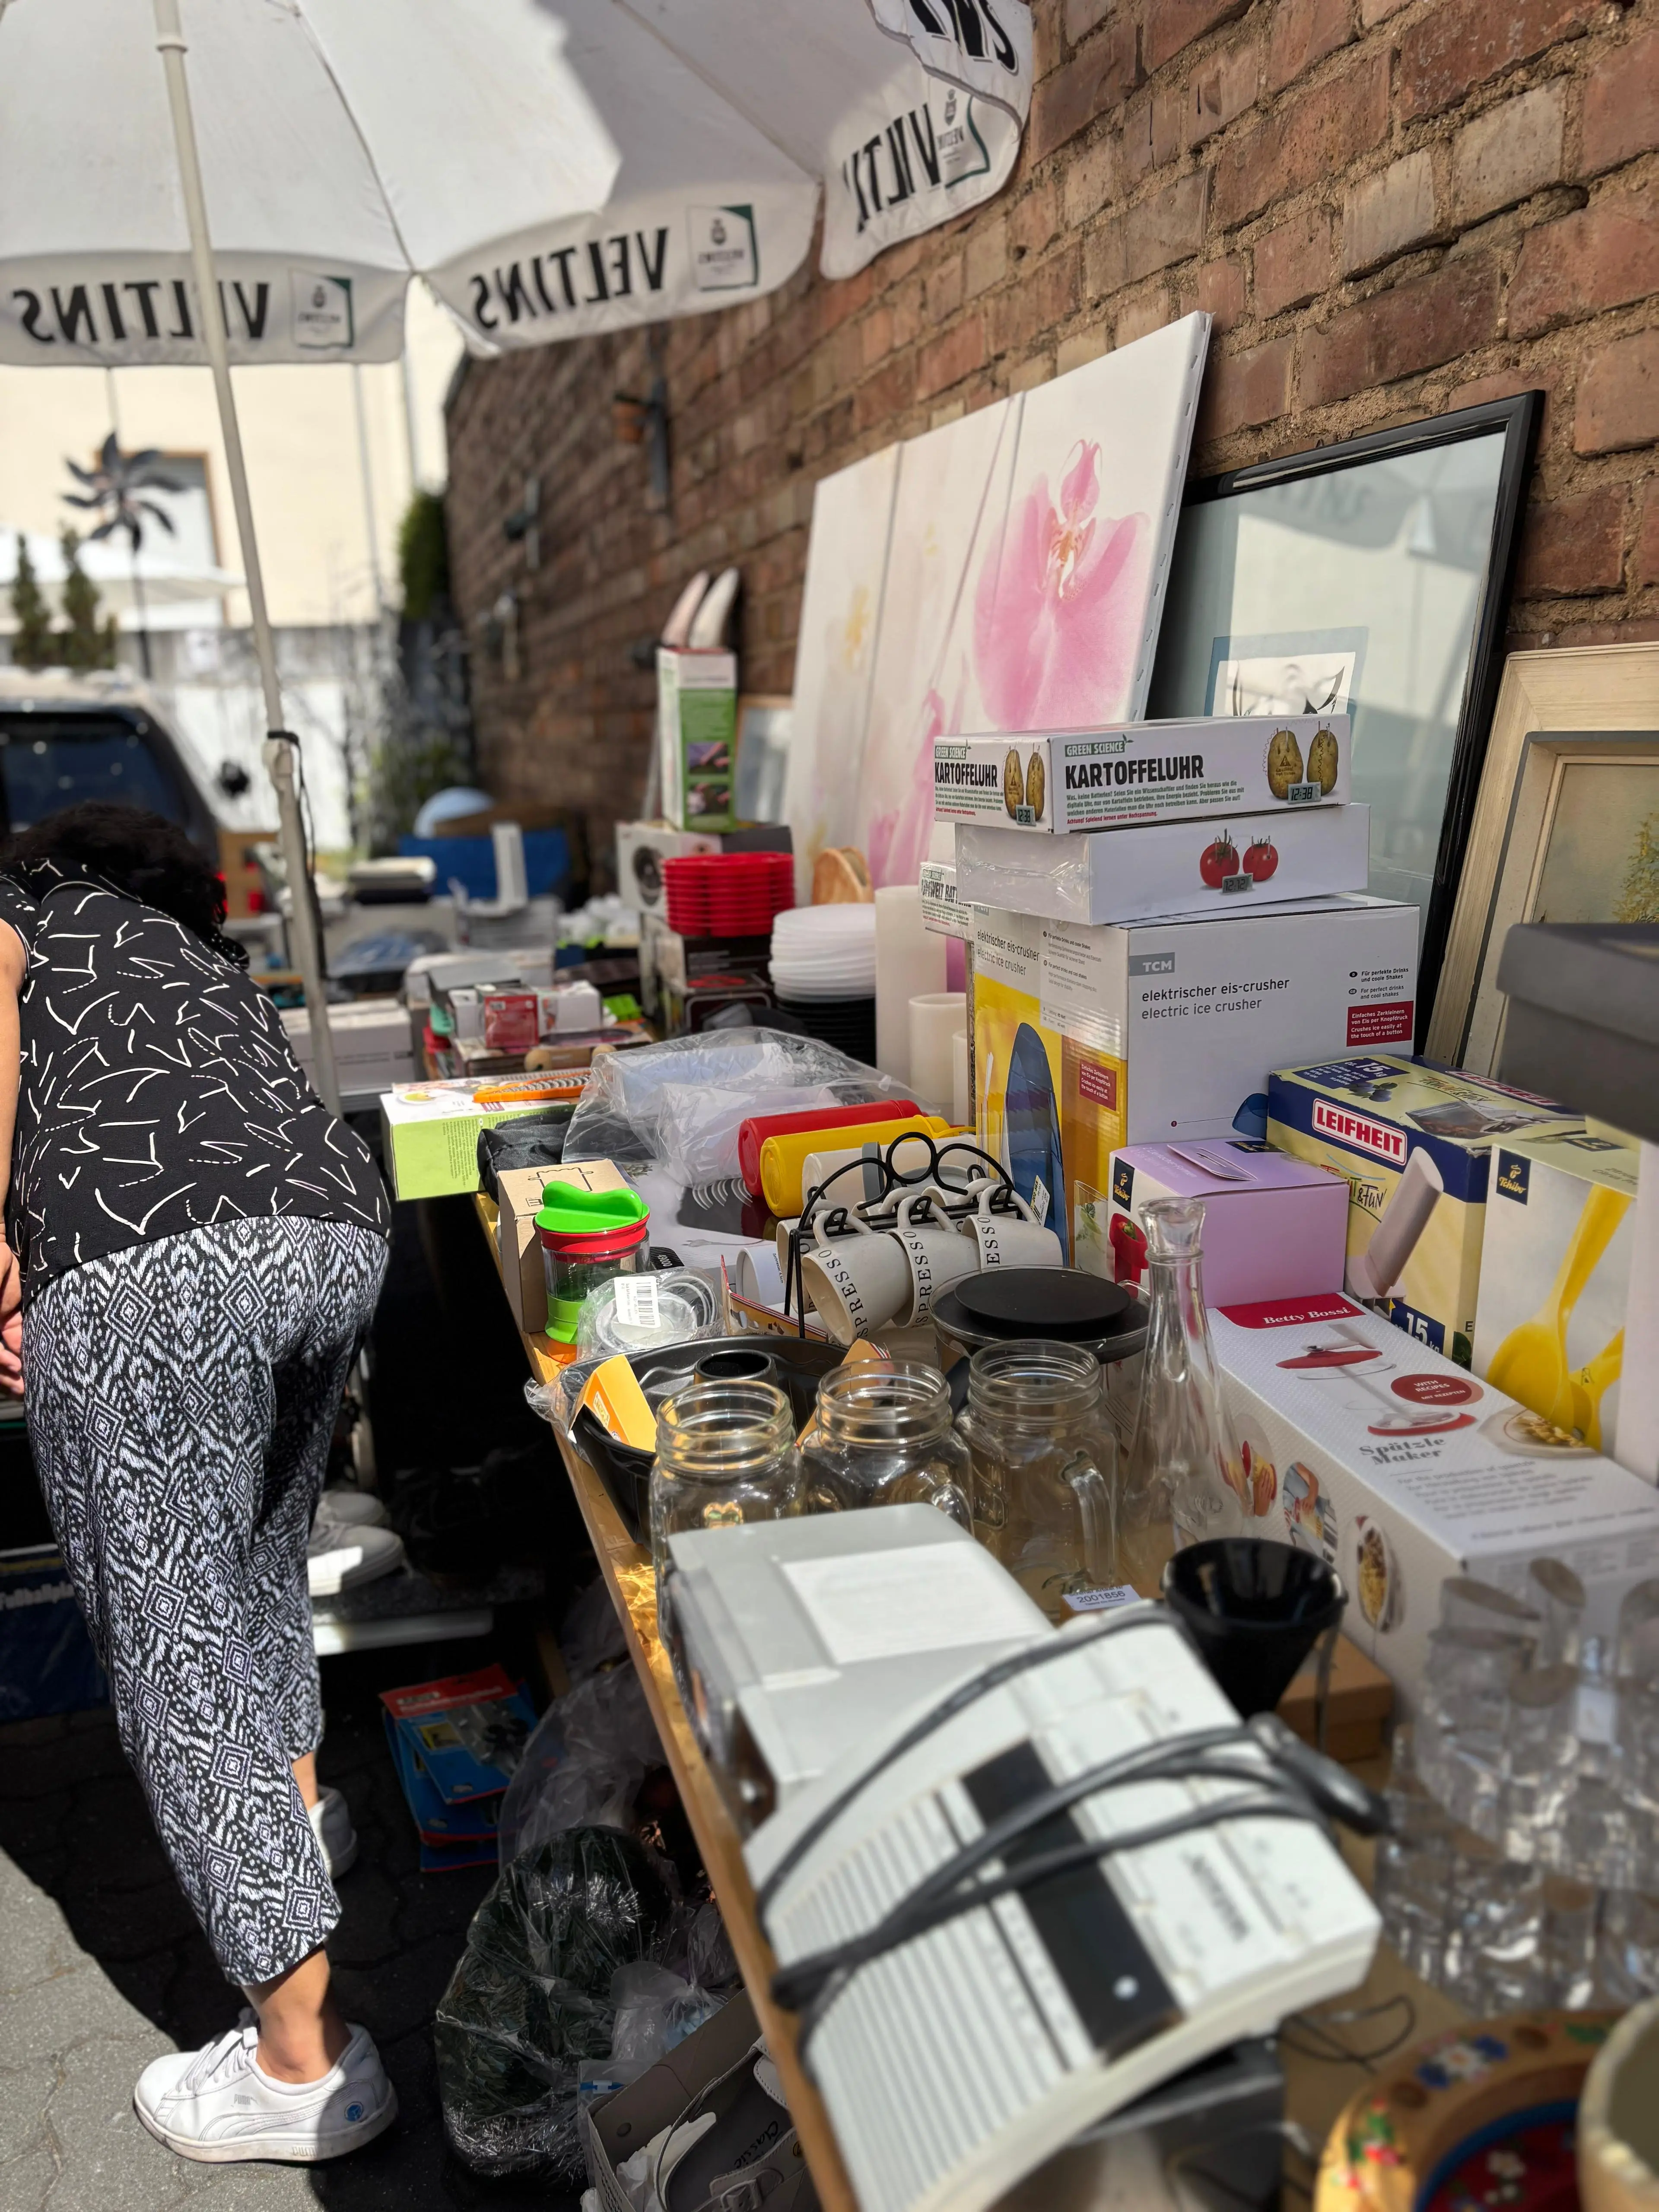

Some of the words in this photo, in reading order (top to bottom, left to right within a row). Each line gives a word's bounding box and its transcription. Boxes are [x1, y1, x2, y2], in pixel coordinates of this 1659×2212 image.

[935, 747, 949, 757] GREEN
[950, 748, 965, 758] SCIENCE
[1067, 743, 1092, 756] GREEN
[1094, 741, 1124, 753] SCIENCE
[935, 762, 998, 788] KARTOFFELUHR
[1065, 755, 1204, 789] KARTOFFELUHR
[1291, 786, 1313, 801] 12:38
[1017, 809, 1031, 823] 12:38
[977, 931, 1005, 950] elektrischer
[1007, 941, 1040, 962] eis-crusher
[977, 948, 995, 965] electric
[1005, 959, 1027, 976] crusher
[1143, 960, 1172, 973] TCM
[1142, 983, 1217, 1002] elektrischer
[1221, 978, 1290, 996] eis-crusher
[1141, 1003, 1189, 1020] electric
[1193, 1003, 1211, 1015] ice
[1215, 998, 1262, 1014] crusher
[1355, 1062, 1392, 1073] 15
[1317, 1106, 1402, 1156] LEIFHEIT
[1113, 1184, 1130, 1201] Tchibo
[1499, 1176, 1527, 1194] Tchibo
[657, 1254, 673, 1267] 49000
[903, 1231, 933, 1328] SPRESSO
[818, 1249, 868, 1338] SPRESSO
[1263, 1313, 1304, 1325] Betty
[1307, 1307, 1351, 1318] Bossi
[1406, 1312, 1429, 1344] 15
[1415, 1383, 1450, 1392] RECIPES
[1434, 1390, 1466, 1398] REZEPTEN
[1359, 1438, 1446, 1457] Spätzle
[1371, 1450, 1442, 1465] Maker
[1076, 1590, 1126, 1603] 2001856
[234, 2094, 251, 2106] PUMA
[734, 2120, 779, 2169] Classic
